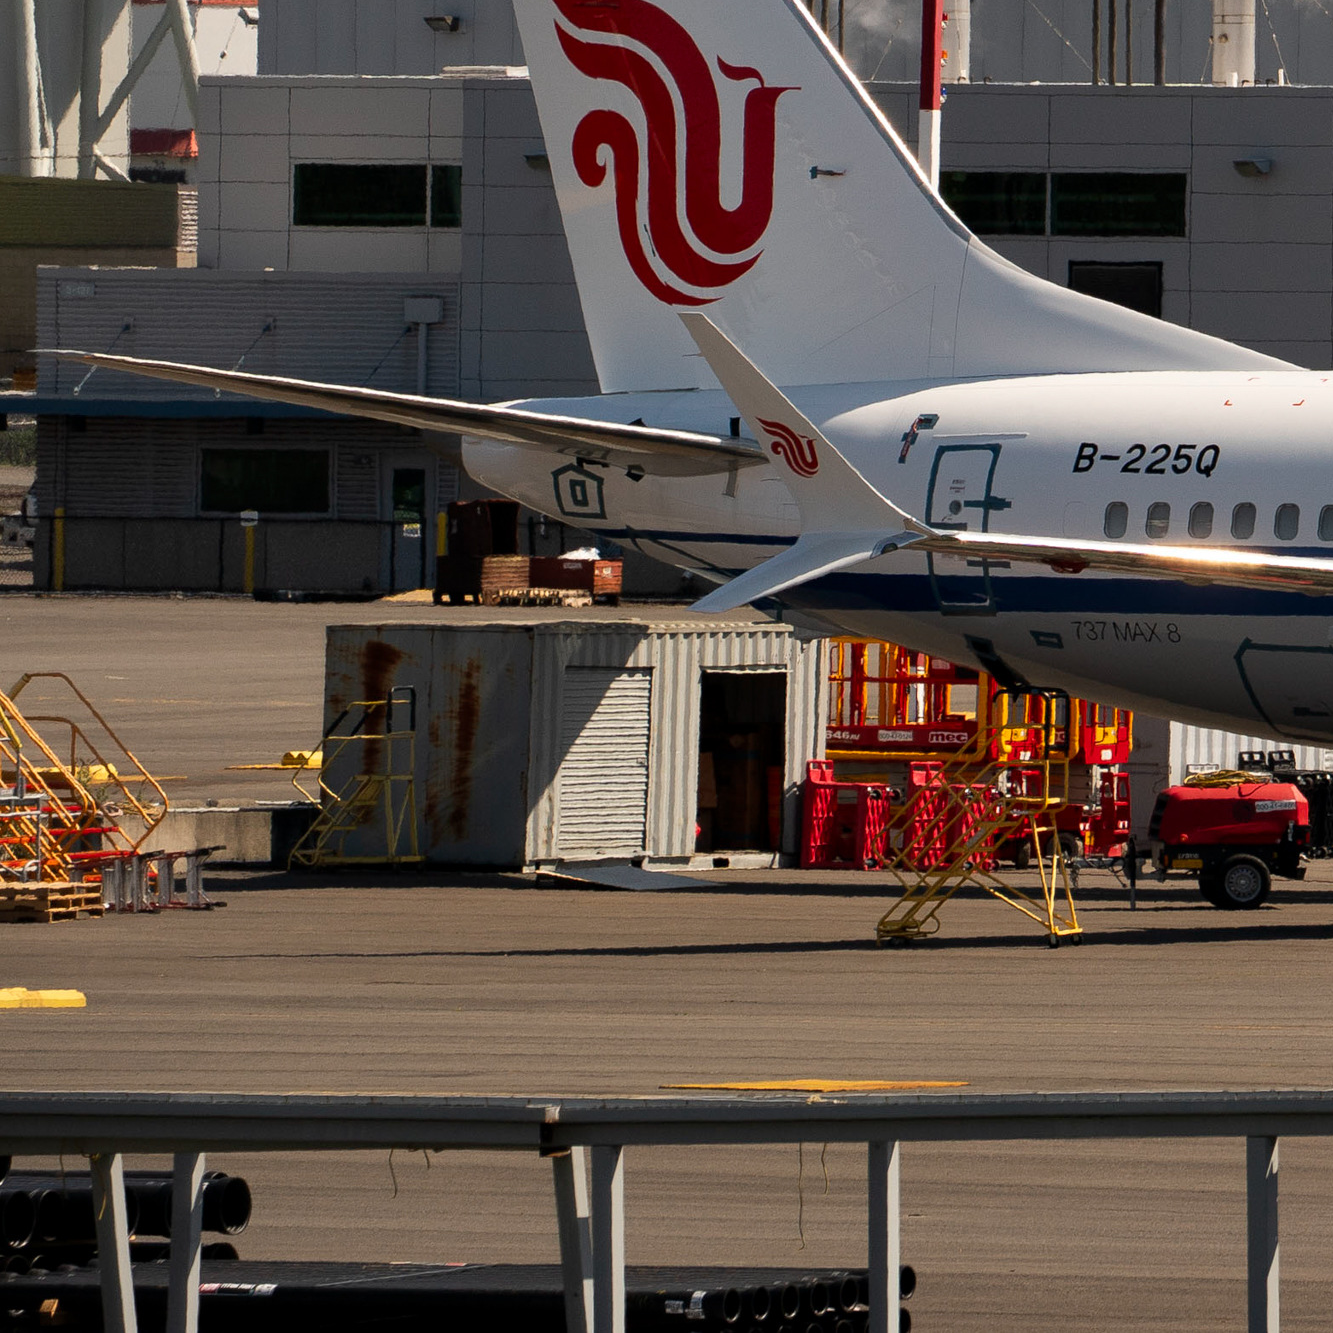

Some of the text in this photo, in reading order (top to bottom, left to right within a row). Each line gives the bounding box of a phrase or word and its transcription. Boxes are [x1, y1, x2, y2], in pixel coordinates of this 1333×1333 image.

[1072, 442, 1221, 478] B-225Q
[1070, 621, 1181, 643] 737 MAX 8
